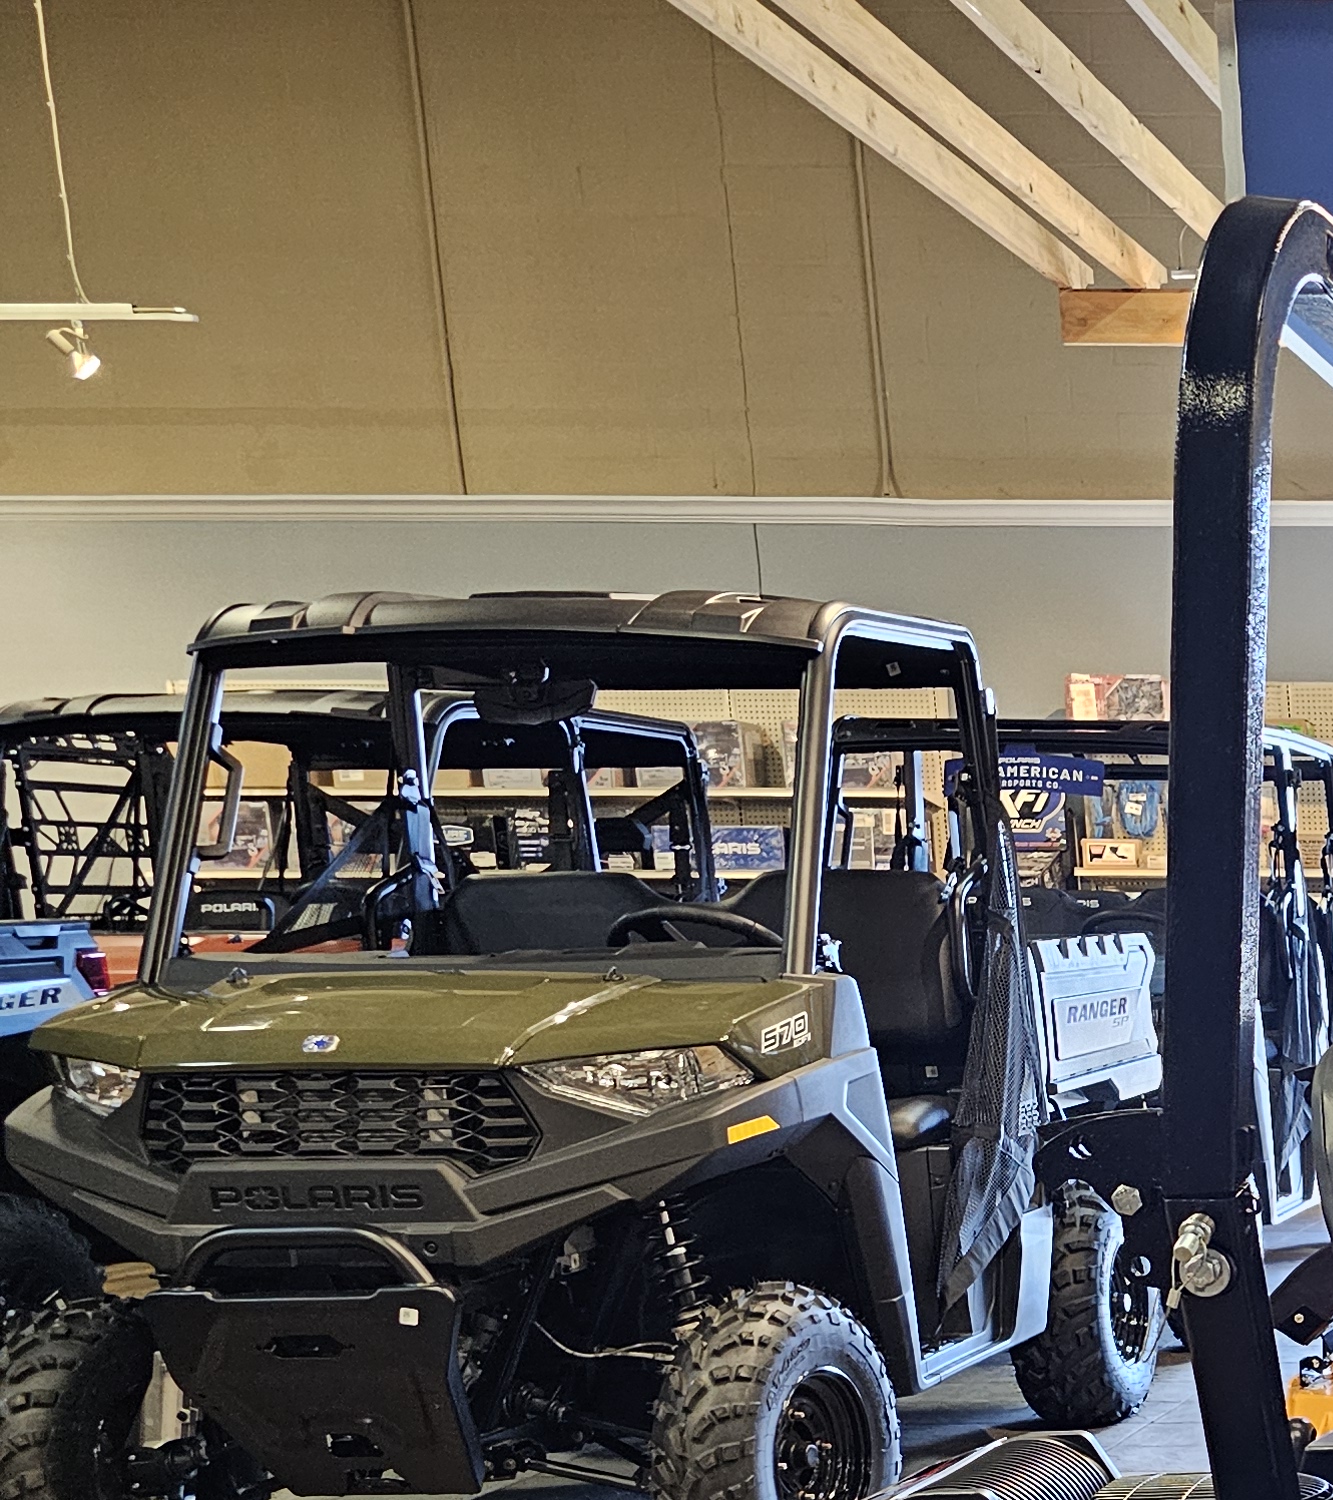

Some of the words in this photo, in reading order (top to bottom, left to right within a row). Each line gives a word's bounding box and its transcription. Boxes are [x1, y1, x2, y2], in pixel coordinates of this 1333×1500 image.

[998, 765, 1083, 782] AMERICAN
[710, 842, 761, 855] ARIS
[201, 903, 259, 913] POLARI
[0, 987, 62, 1010] GER
[1067, 997, 1127, 1023] RANGER
[1113, 1015, 1129, 1028] SP
[761, 1011, 808, 1054] 570
[209, 1184, 424, 1212] POLARIS
